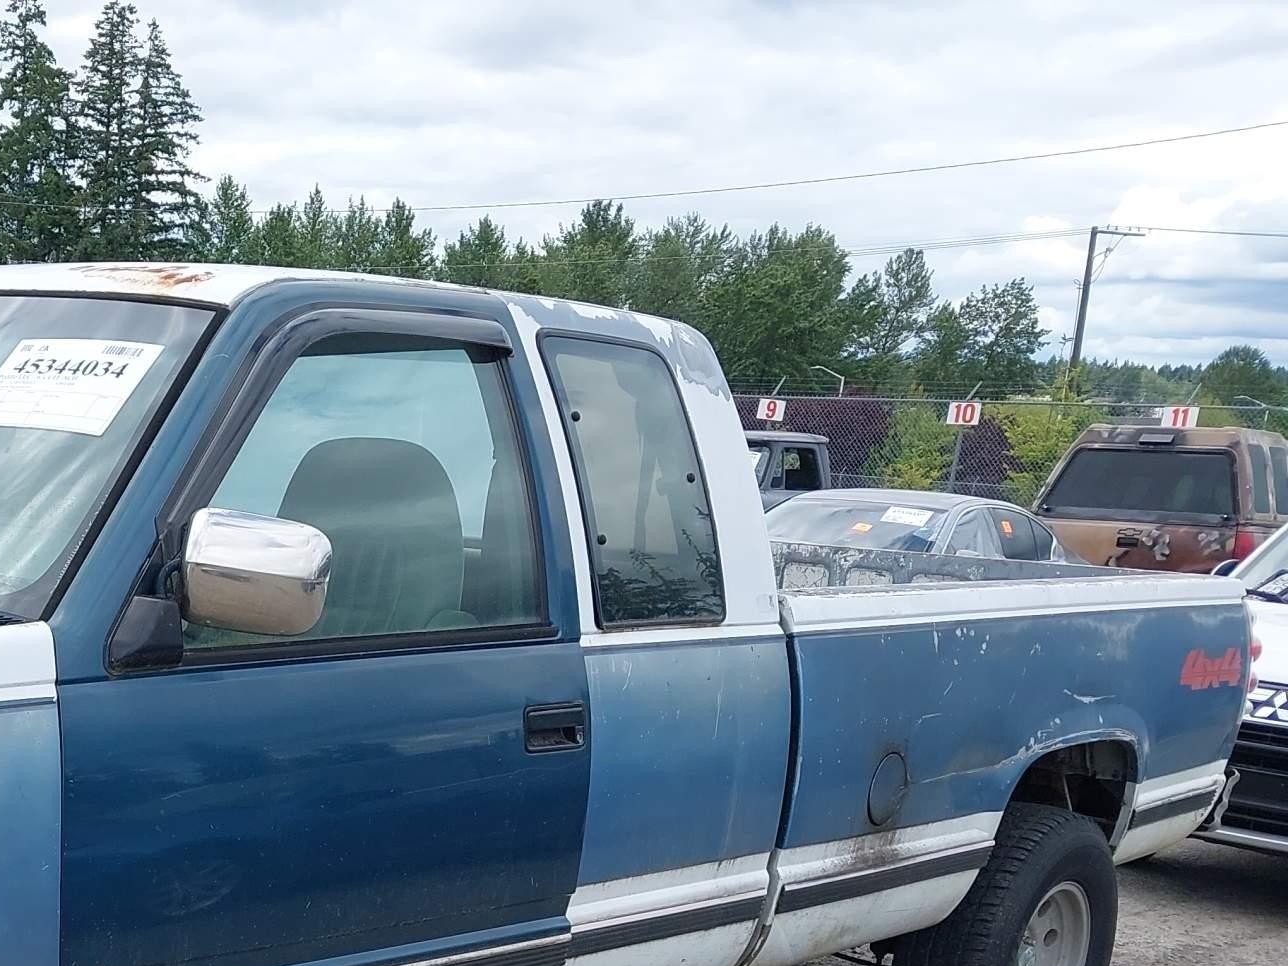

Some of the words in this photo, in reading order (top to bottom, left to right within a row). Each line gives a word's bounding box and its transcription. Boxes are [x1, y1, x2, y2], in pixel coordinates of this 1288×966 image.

[13, 358, 129, 379] 45344034
[766, 400, 778, 418] 9
[954, 403, 976, 423] 10
[1171, 407, 1190, 426] 11
[1181, 647, 1241, 690] 4x4
